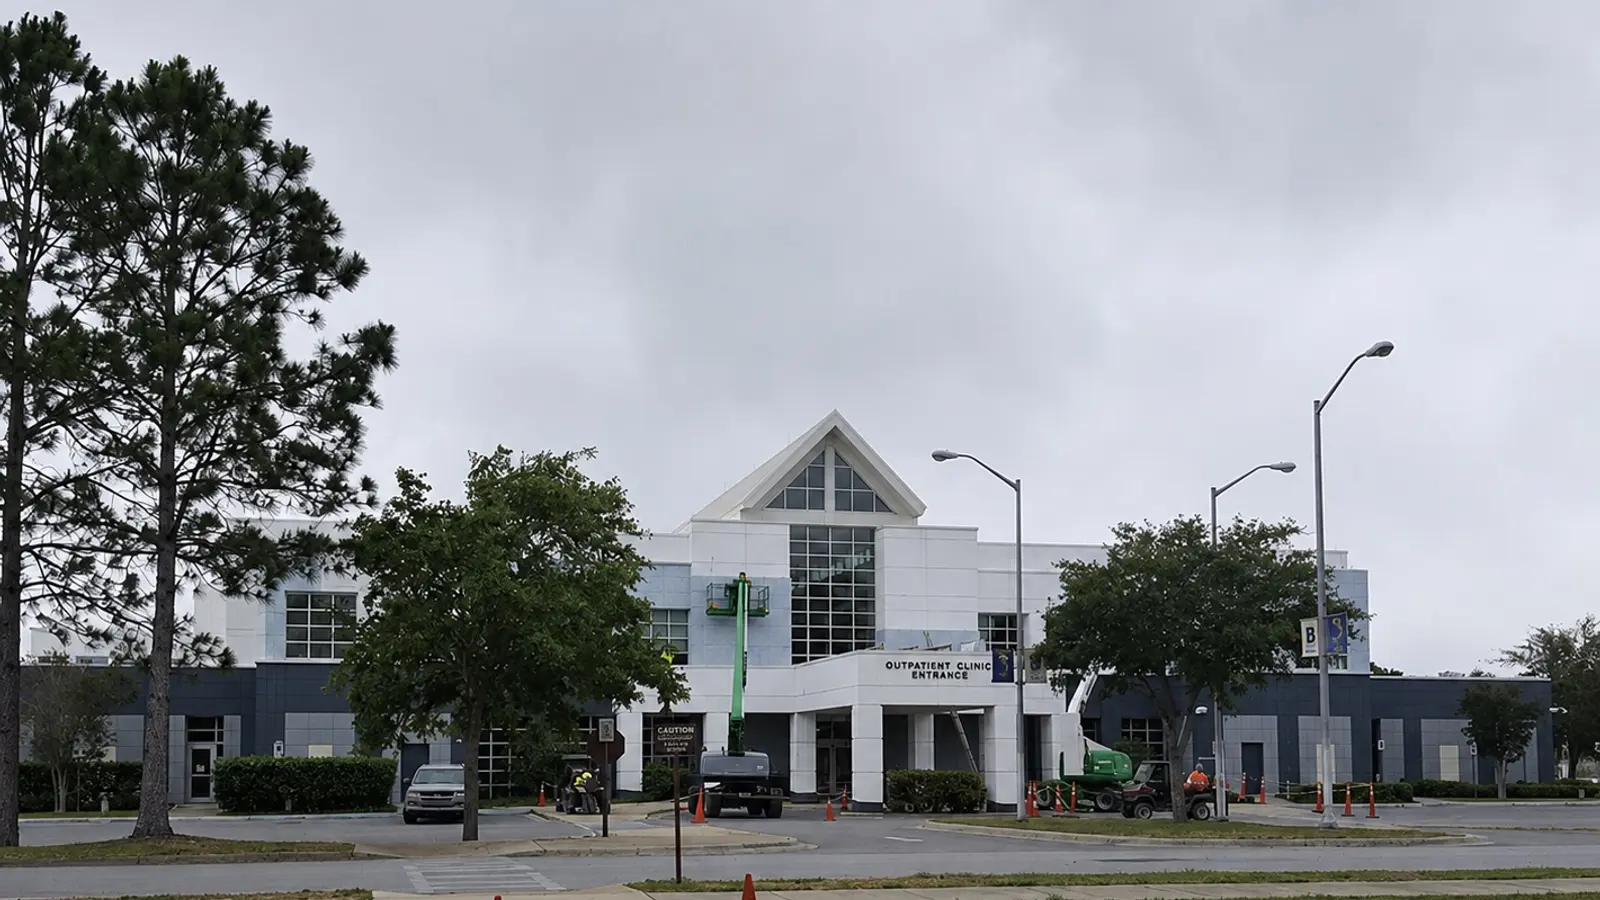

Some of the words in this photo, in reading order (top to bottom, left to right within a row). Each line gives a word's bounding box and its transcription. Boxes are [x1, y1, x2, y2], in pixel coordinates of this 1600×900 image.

[1306, 627, 1315, 643] B
[885, 661, 951, 670] OUTPATIENT
[957, 662, 991, 671] CLINIC
[912, 671, 968, 679] ENTRANCE
[657, 726, 694, 734] CAUTION
